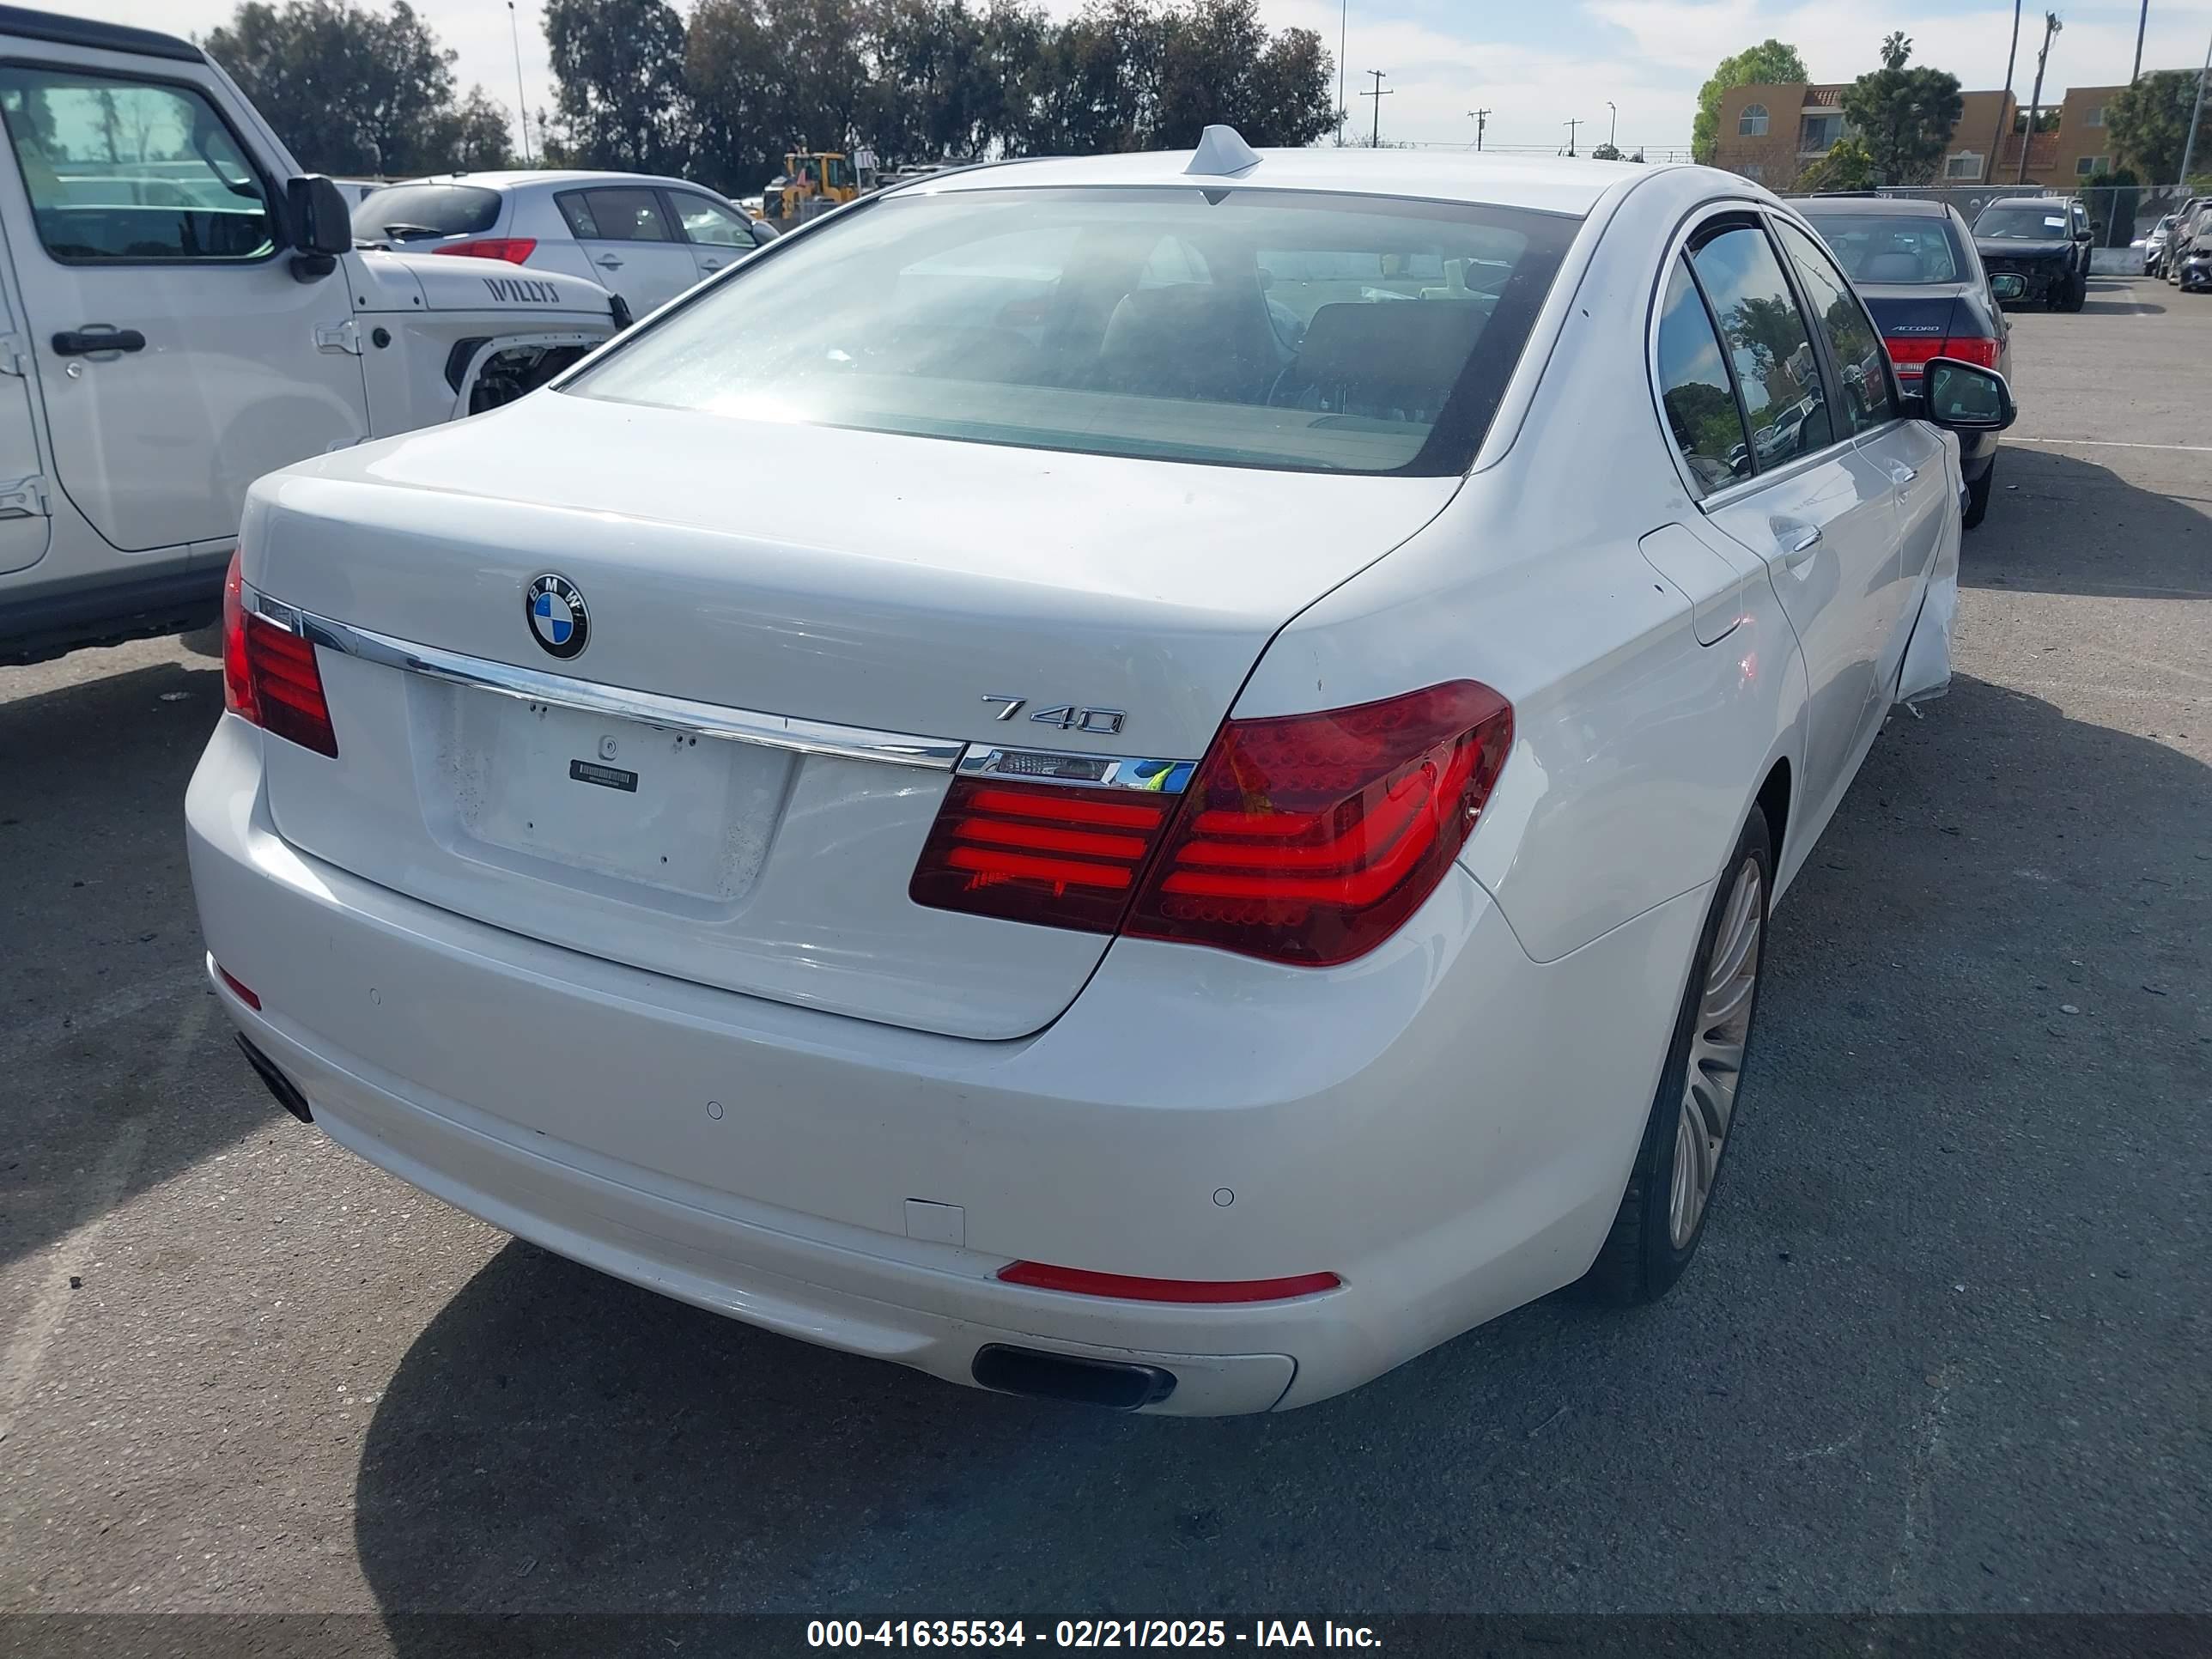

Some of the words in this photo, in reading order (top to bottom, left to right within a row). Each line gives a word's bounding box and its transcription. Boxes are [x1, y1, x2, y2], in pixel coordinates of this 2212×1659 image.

[482, 277, 560, 303] WILLYS
[529, 577, 581, 609] BMW
[981, 694, 1127, 735] 740
